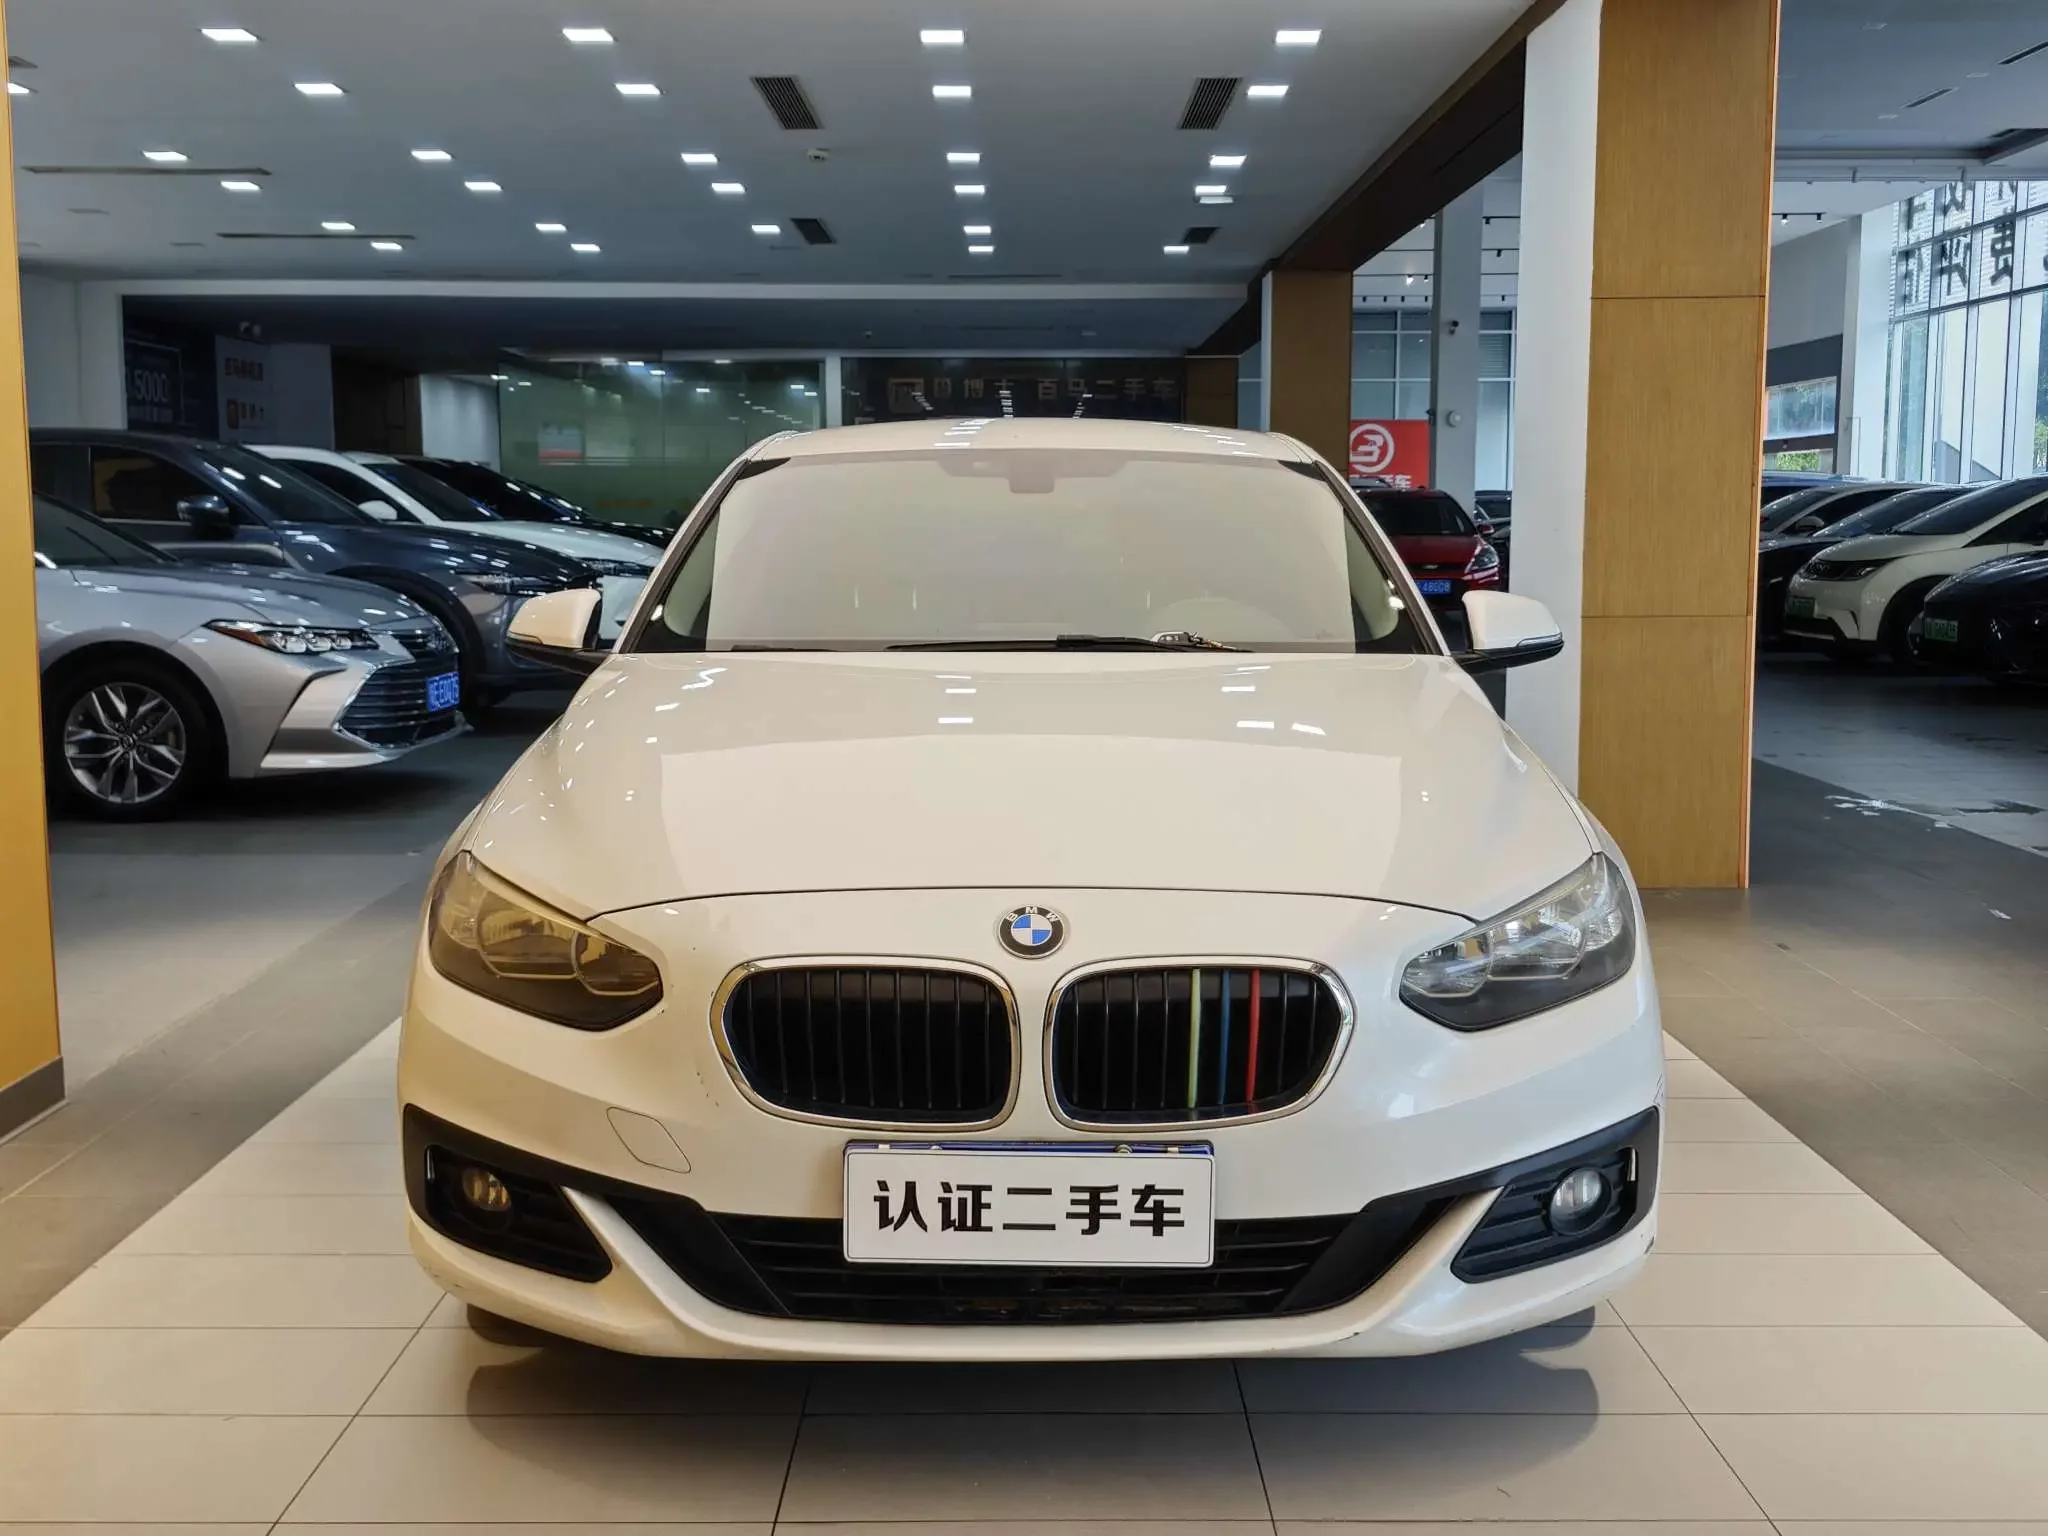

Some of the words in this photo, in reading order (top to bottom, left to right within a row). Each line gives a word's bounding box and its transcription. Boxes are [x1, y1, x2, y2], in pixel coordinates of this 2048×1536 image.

[1006, 905, 1060, 923] BMW
[873, 1179, 1186, 1237] 认证二手车
